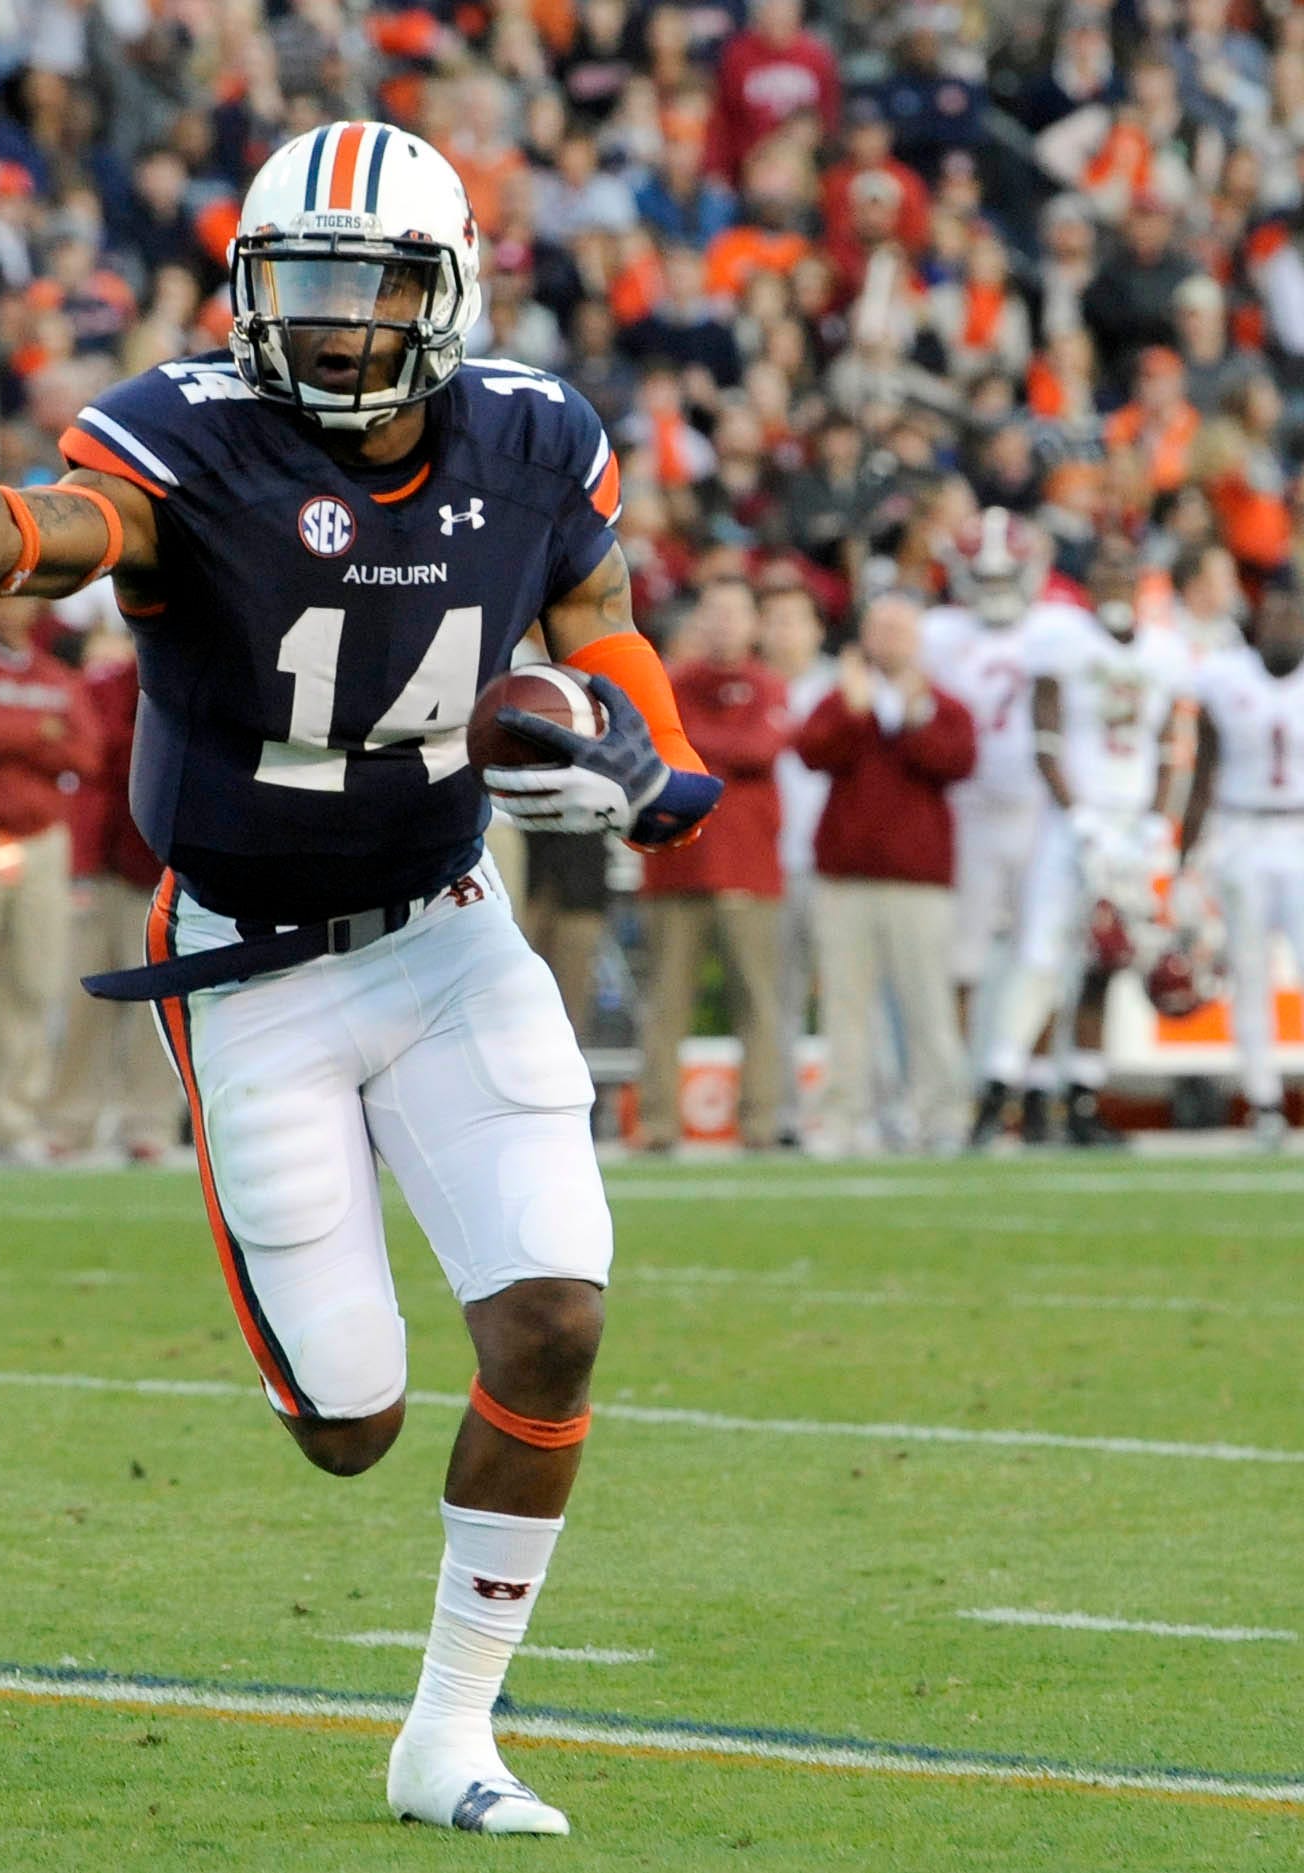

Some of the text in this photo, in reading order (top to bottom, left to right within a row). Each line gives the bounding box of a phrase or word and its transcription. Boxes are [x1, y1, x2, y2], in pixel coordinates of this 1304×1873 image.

[316, 214, 361, 229] TIGERS
[302, 501, 352, 554] SEC
[342, 562, 448, 586] AUBURN
[253, 604, 483, 793] 14
